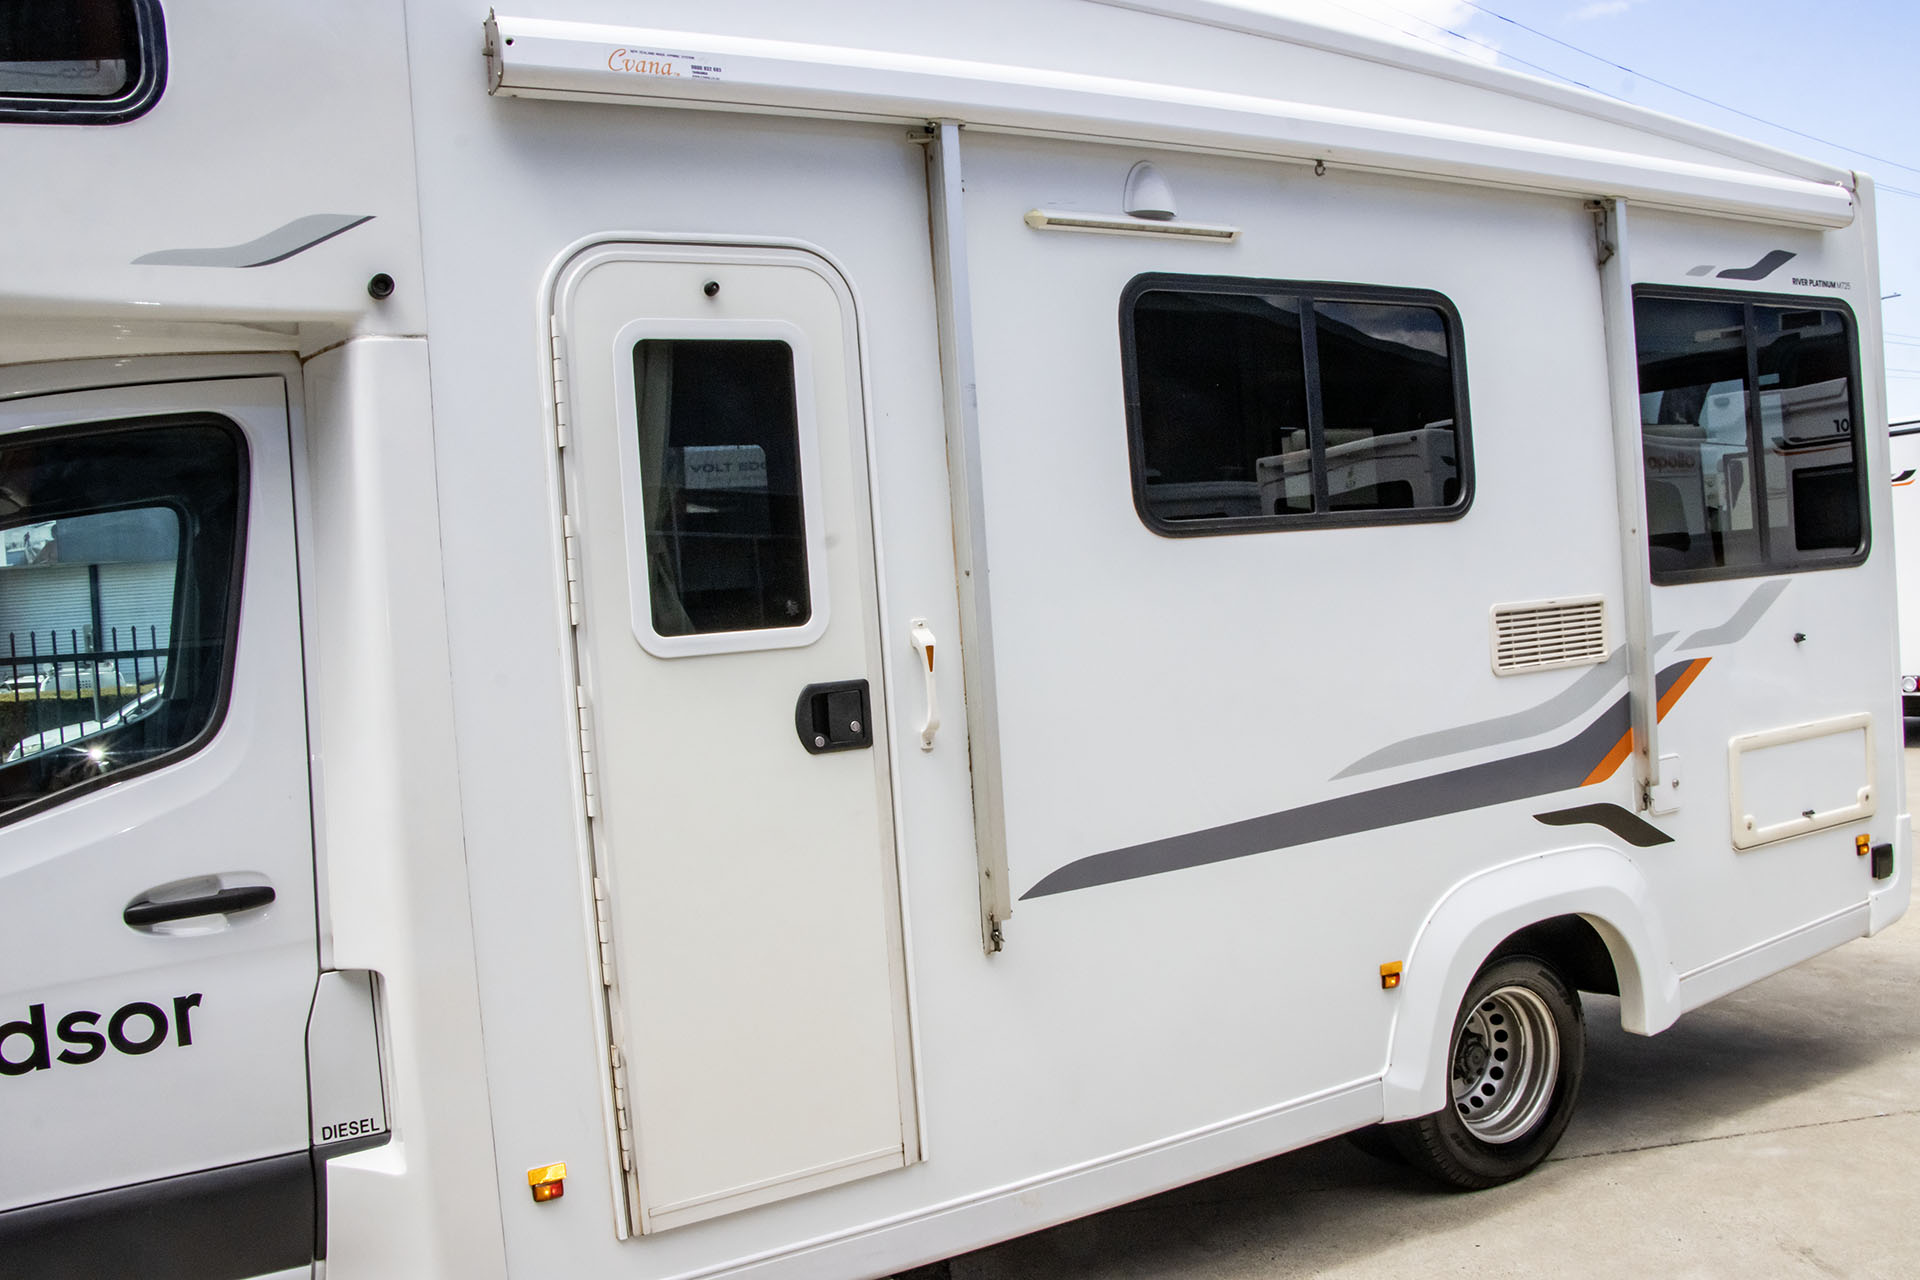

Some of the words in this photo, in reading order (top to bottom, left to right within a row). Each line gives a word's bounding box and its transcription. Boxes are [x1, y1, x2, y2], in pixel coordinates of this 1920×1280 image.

[608, 48, 673, 76] Cvana
[1792, 277, 1808, 287] RIVER
[1808, 278, 1836, 289] PLATINUM
[690, 462, 733, 473] VOLT
[0, 993, 203, 1076] dsor
[321, 1117, 380, 1141] DIESEL
